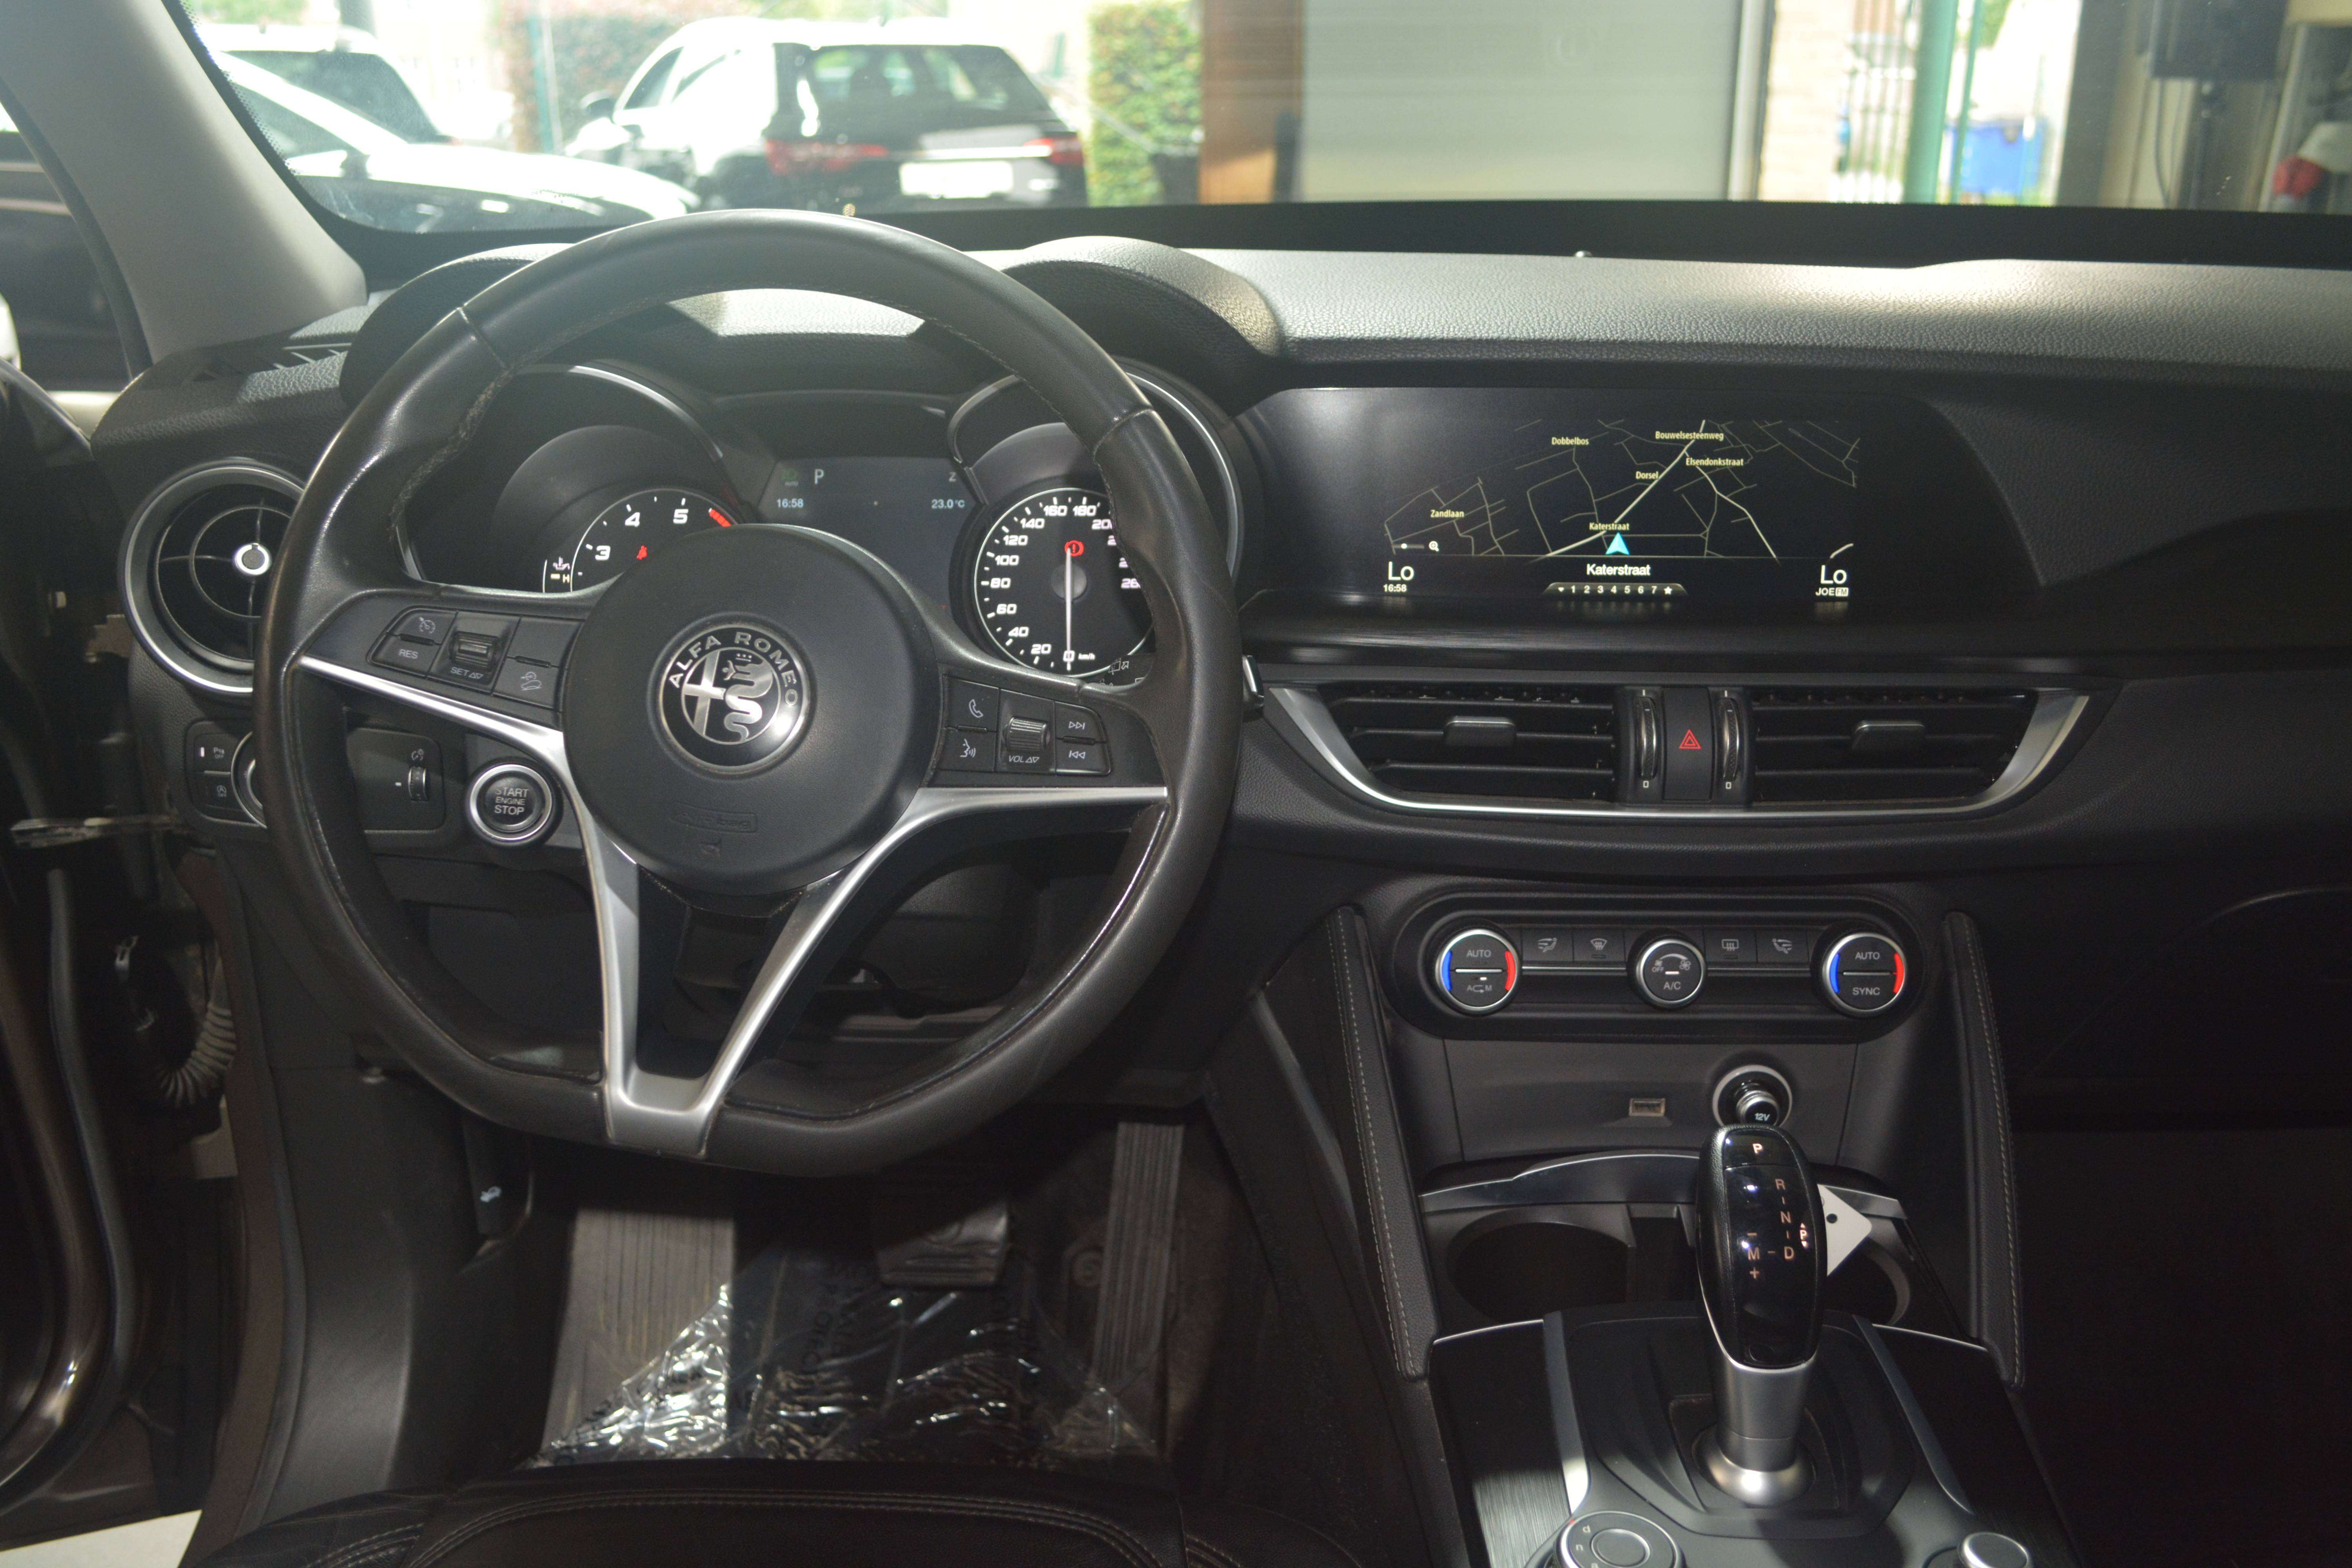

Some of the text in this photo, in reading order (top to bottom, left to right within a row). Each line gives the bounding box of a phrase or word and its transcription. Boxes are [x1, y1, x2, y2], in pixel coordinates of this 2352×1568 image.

[1552, 437, 1589, 445] Dobbelbos
[1655, 432, 1724, 441] Bouwelsesteenweg
[1686, 457, 1744, 466] Elsendonkstraat
[815, 469, 824, 484] P
[1636, 471, 1659, 480] Dorsel
[777, 498, 804, 508] 16:58
[1044, 505, 1067, 516] 160
[1073, 505, 1096, 517] 180
[625, 512, 640, 527] 4
[673, 508, 688, 524] 5
[1020, 518, 1045, 529] 140
[1589, 522, 1630, 530] Katerstraat
[1003, 535, 1028, 546] 120
[595, 545, 610, 561] 3
[995, 555, 1019, 565] 100
[1388, 561, 1414, 581] Lo
[1586, 564, 1651, 575] Katerstraat
[1820, 564, 1847, 584] Lo
[991, 578, 1011, 588] 80
[1383, 584, 1407, 592] 16:58
[1571, 585, 1657, 594] 1 2 3 4 5 6 7
[1815, 588, 1835, 596] JOE
[996, 604, 1017, 614] 60
[1008, 627, 1029, 637] 40
[399, 649, 418, 659] RES
[1031, 644, 1051, 655] 20
[1063, 650, 1074, 662] 0
[451, 667, 470, 676] SET
[668, 632, 799, 706] ALFA ROMEO
[1009, 755, 1024, 763] VOL
[495, 787, 529, 797] START
[496, 796, 526, 805] ENGINE
[495, 805, 524, 815] STOP
[1664, 982, 1681, 990] A/C
[1853, 987, 1880, 995] SYNC
[1755, 1112, 1770, 1121] 12V
[1753, 1143, 1763, 1154] P
[1775, 1178, 1786, 1190] R
[1780, 1211, 1791, 1223] N
[1748, 1247, 1760, 1260] M
[1784, 1246, 1795, 1259] D
